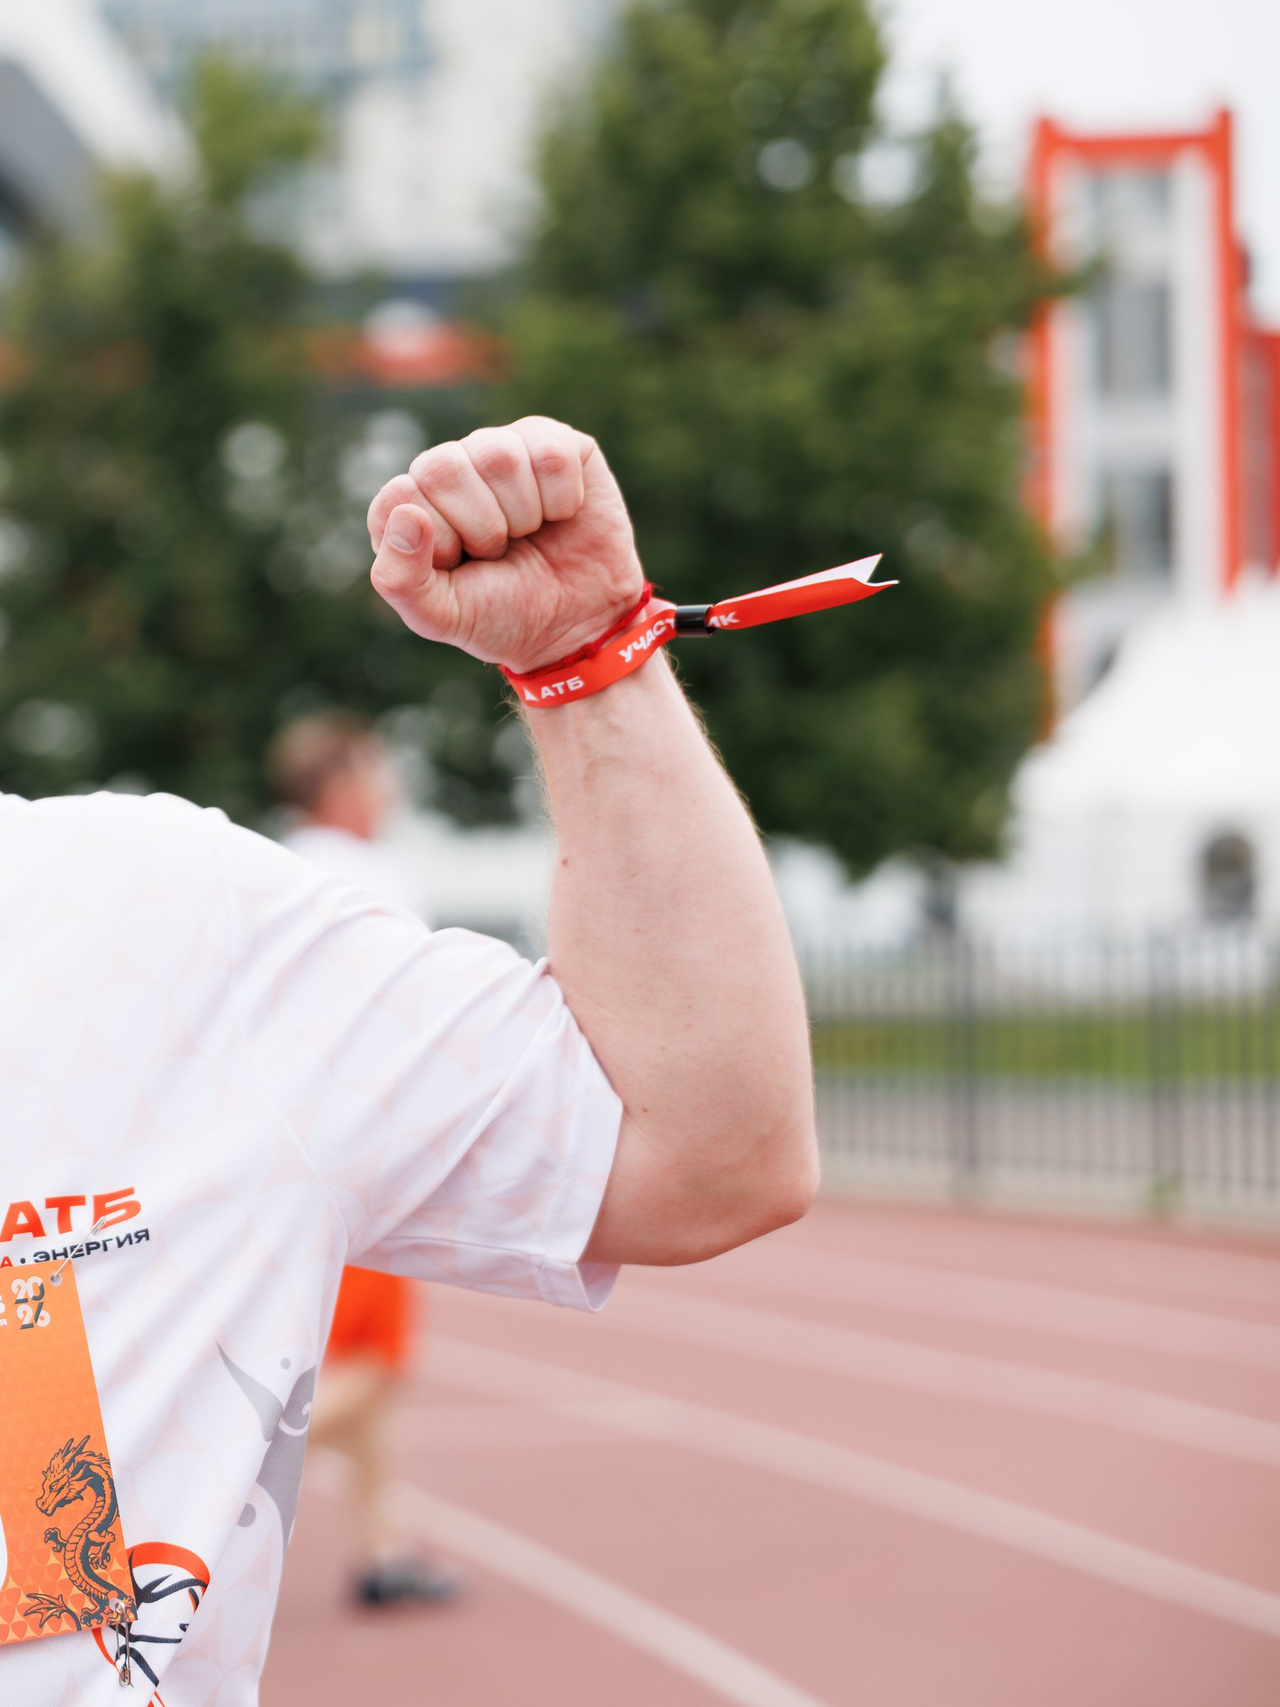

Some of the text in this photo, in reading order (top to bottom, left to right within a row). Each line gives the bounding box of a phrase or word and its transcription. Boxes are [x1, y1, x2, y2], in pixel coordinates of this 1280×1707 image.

[540, 611, 739, 699] АТБ УЧАСТИК
[33, 1228, 150, 1264] ЭНЕРГИЯ
[11, 1276, 45, 1304] 20
[16, 1301, 51, 1330] 26
